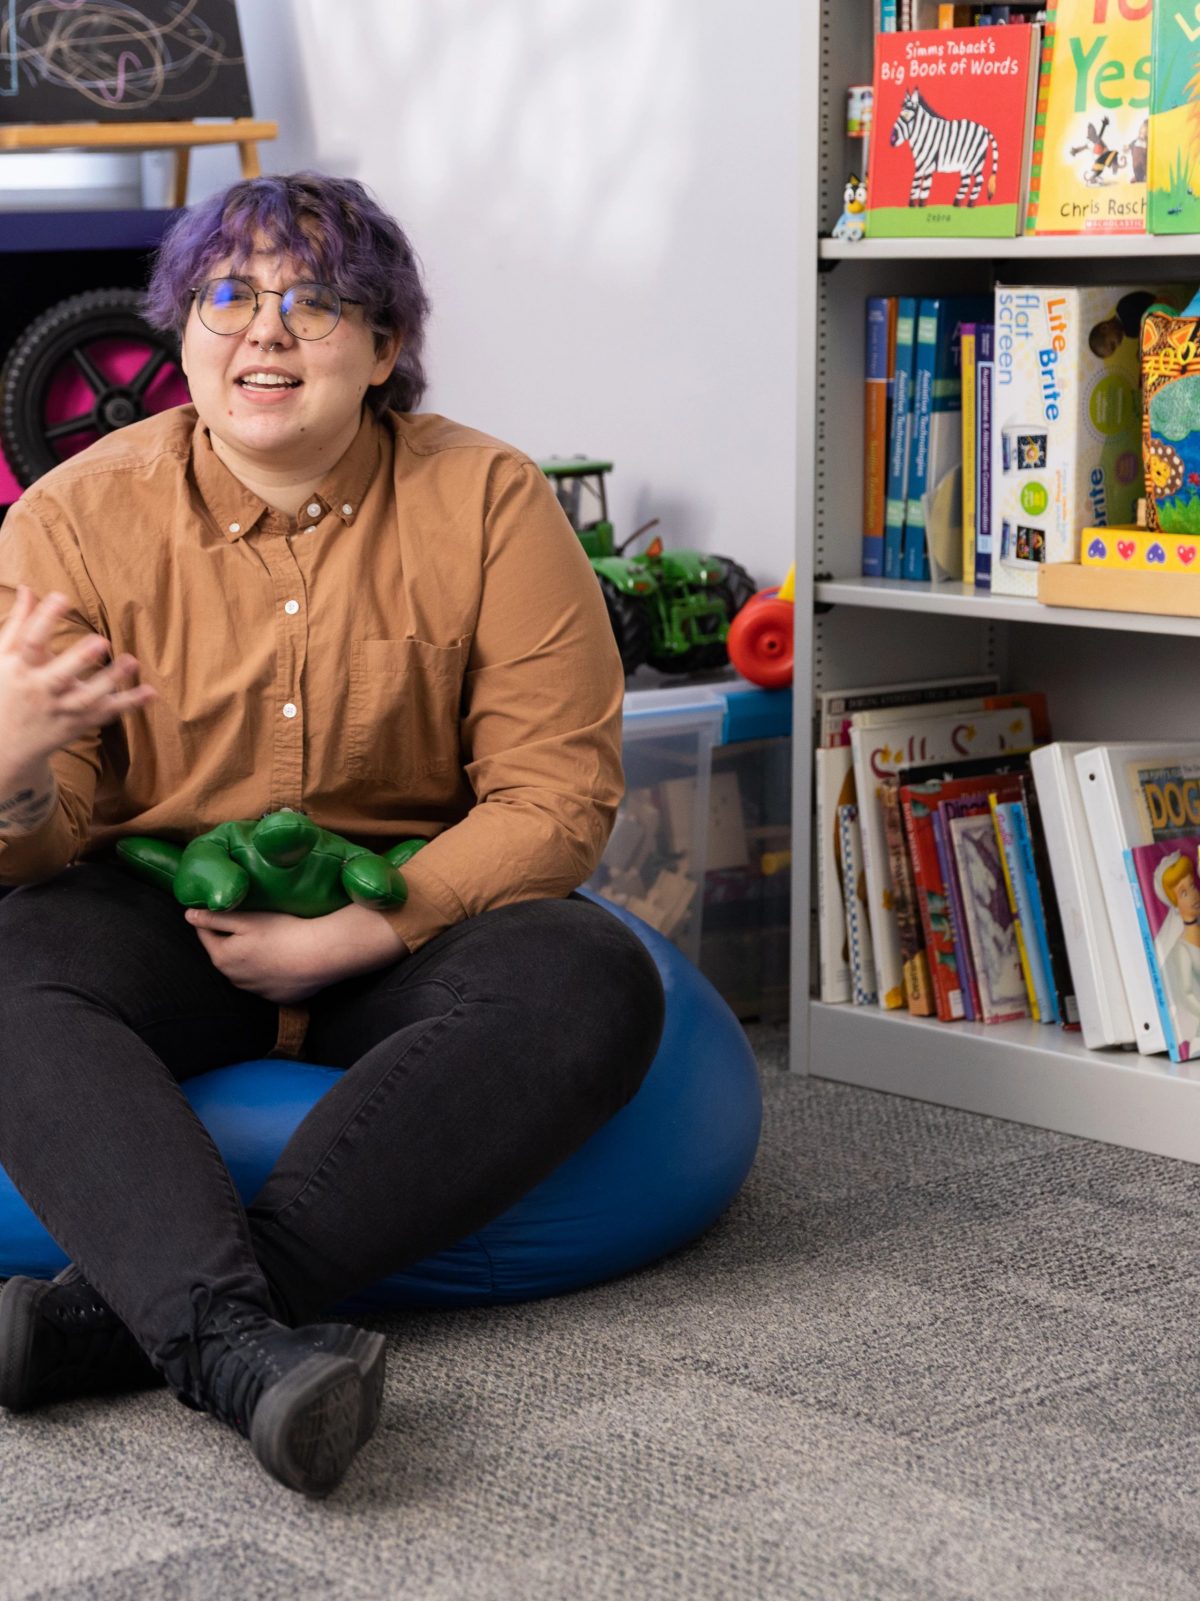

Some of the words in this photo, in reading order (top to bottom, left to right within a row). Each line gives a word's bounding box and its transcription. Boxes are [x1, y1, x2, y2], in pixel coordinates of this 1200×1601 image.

[881, 61, 905, 85] Big
[910, 58, 947, 77] Book
[950, 57, 967, 75] of
[970, 56, 1019, 75] Words
[906, 41, 944, 60] Simms
[947, 37, 996, 55] Taback's
[1060, 201, 1100, 217] Chris
[1015, 294, 1040, 339] flat
[1047, 298, 1067, 352] Lite
[999, 294, 1013, 385] screen
[1039, 348, 1061, 421] Brite
